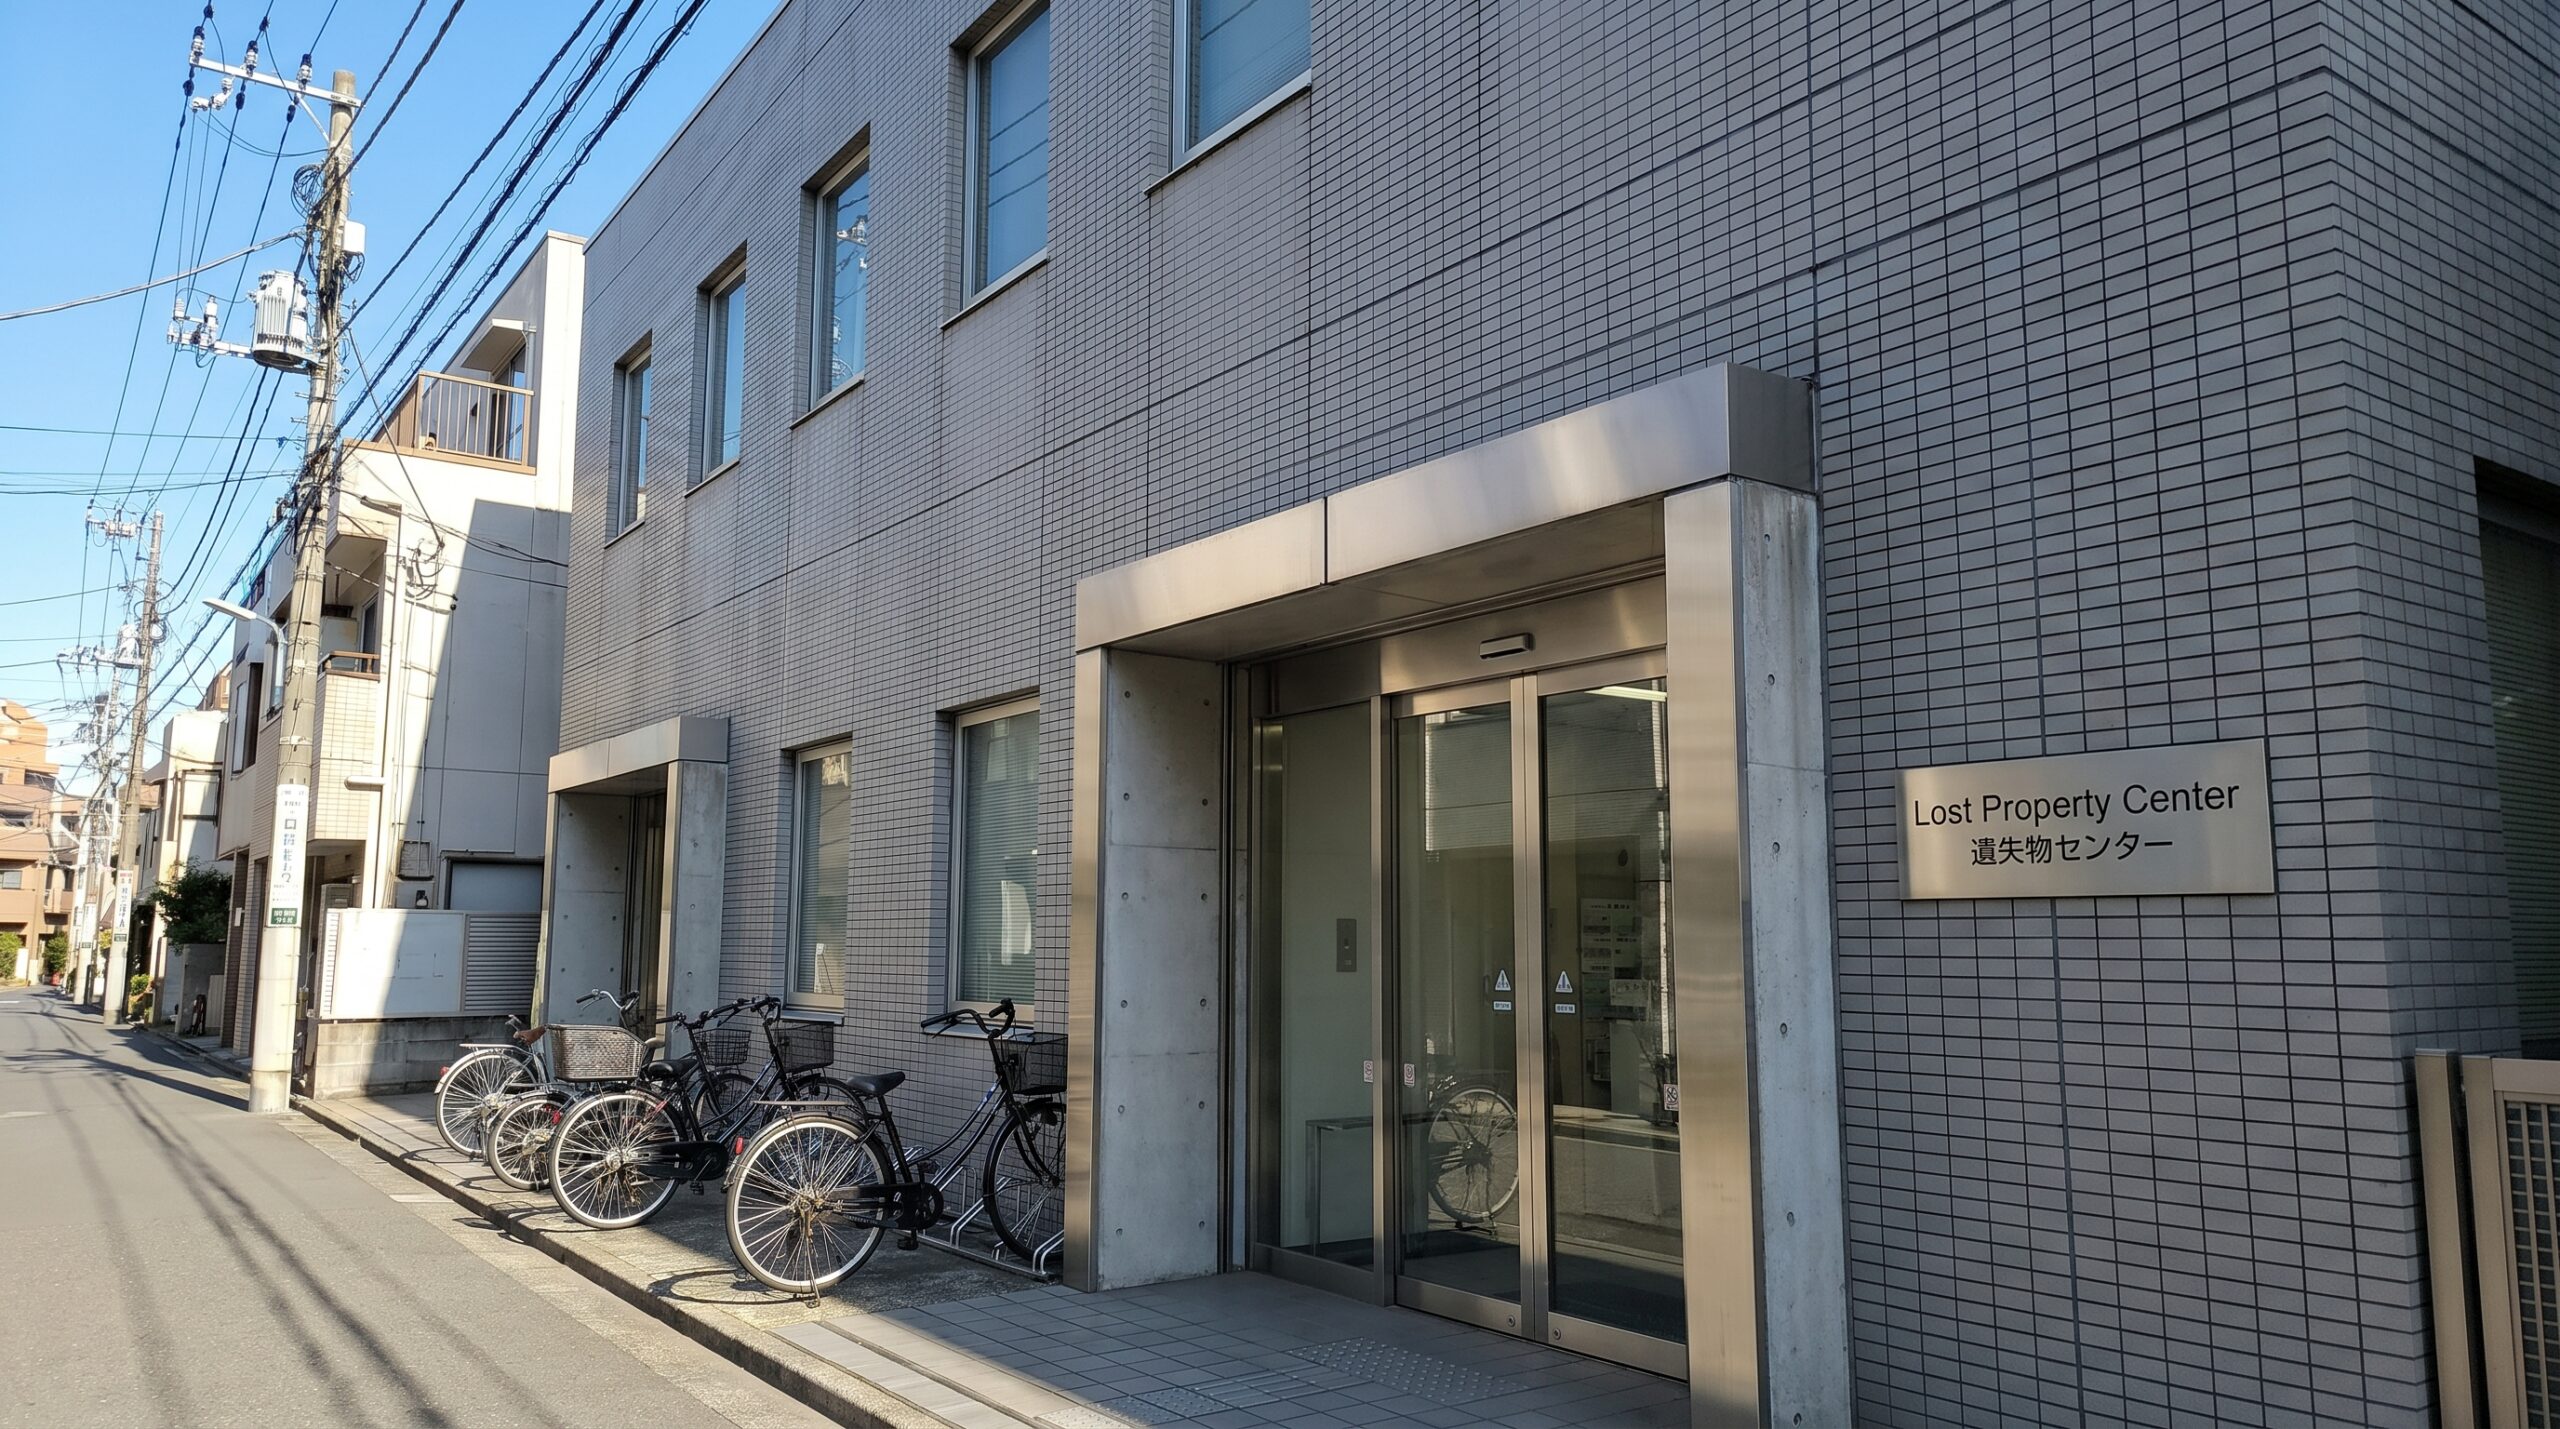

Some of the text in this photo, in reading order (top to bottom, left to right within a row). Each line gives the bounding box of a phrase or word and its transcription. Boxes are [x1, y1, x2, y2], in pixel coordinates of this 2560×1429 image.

[1914, 780, 2240, 828] Lost Property Center
[1971, 830, 2174, 866] 遺失物センター
